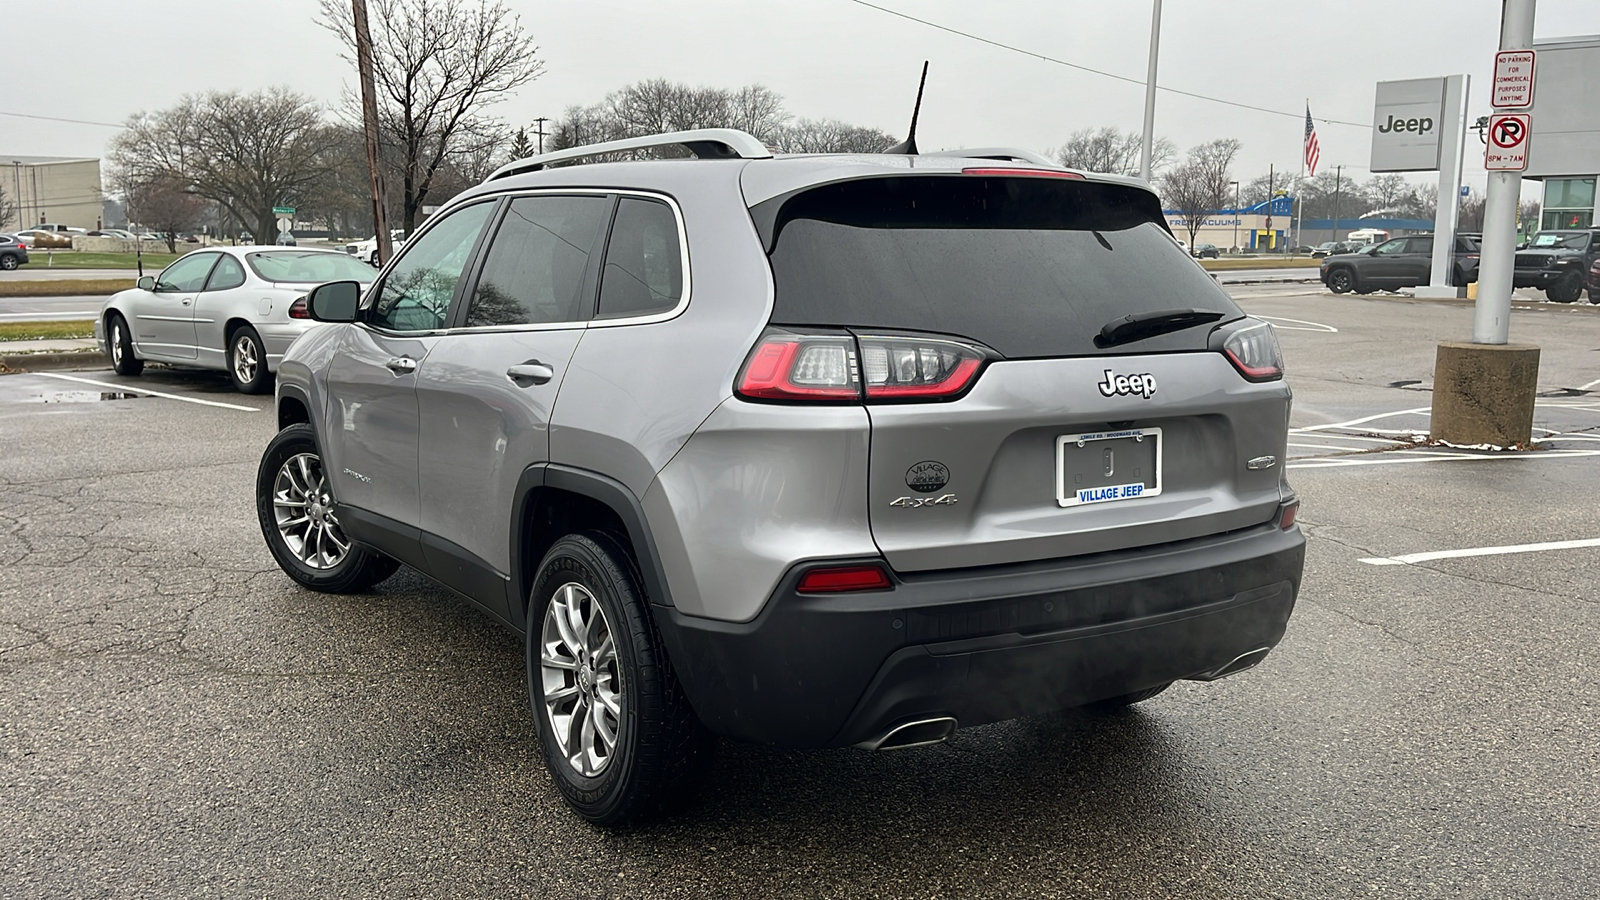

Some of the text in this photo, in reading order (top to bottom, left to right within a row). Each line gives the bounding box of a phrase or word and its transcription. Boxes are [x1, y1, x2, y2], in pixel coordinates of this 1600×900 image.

[1498, 85, 1527, 93] PURPOSES
[1378, 114, 1433, 136] Jeep
[1509, 154, 1524, 162] 7AM
[1097, 368, 1157, 400] Jeep
[911, 463, 946, 475] VILLAGE
[1080, 484, 1143, 502] VILLAGE JEEP
